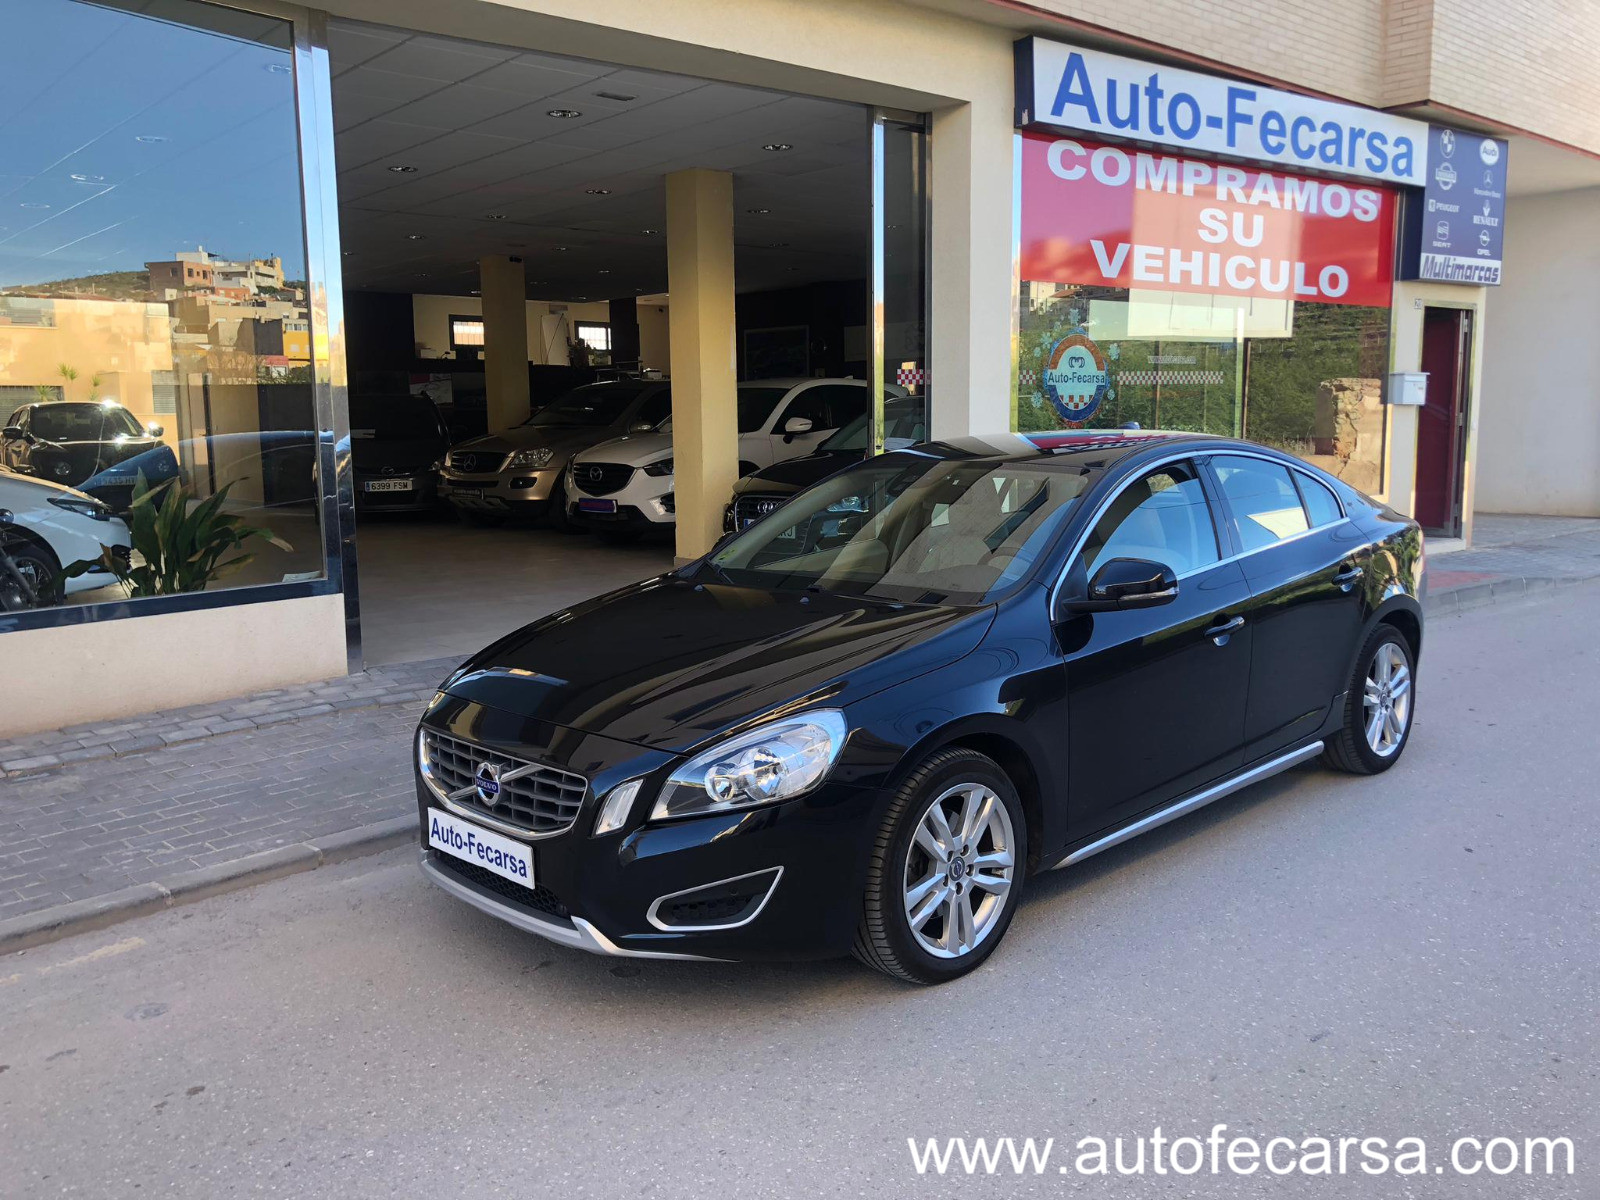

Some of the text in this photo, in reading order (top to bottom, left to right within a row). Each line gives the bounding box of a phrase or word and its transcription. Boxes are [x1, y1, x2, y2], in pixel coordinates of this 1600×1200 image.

[1051, 52, 1414, 178] Auto-Fecarsa
[1482, 145, 1498, 157] Audi
[1047, 139, 1379, 222] COMPRAMOS
[1436, 203, 1460, 213] PEUGEOT
[1473, 215, 1499, 226] RENAULT
[1197, 207, 1265, 248] SU
[1477, 248, 1491, 256] OPEL
[1090, 239, 1349, 298] VEHICULO
[1422, 255, 1499, 282] Multimarcas
[1048, 372, 1105, 383] Auto-Fecarsa
[371, 482, 391, 490] 6399
[476, 778, 497, 791] VOLVO
[431, 818, 527, 877] Auto-Fecarsa
